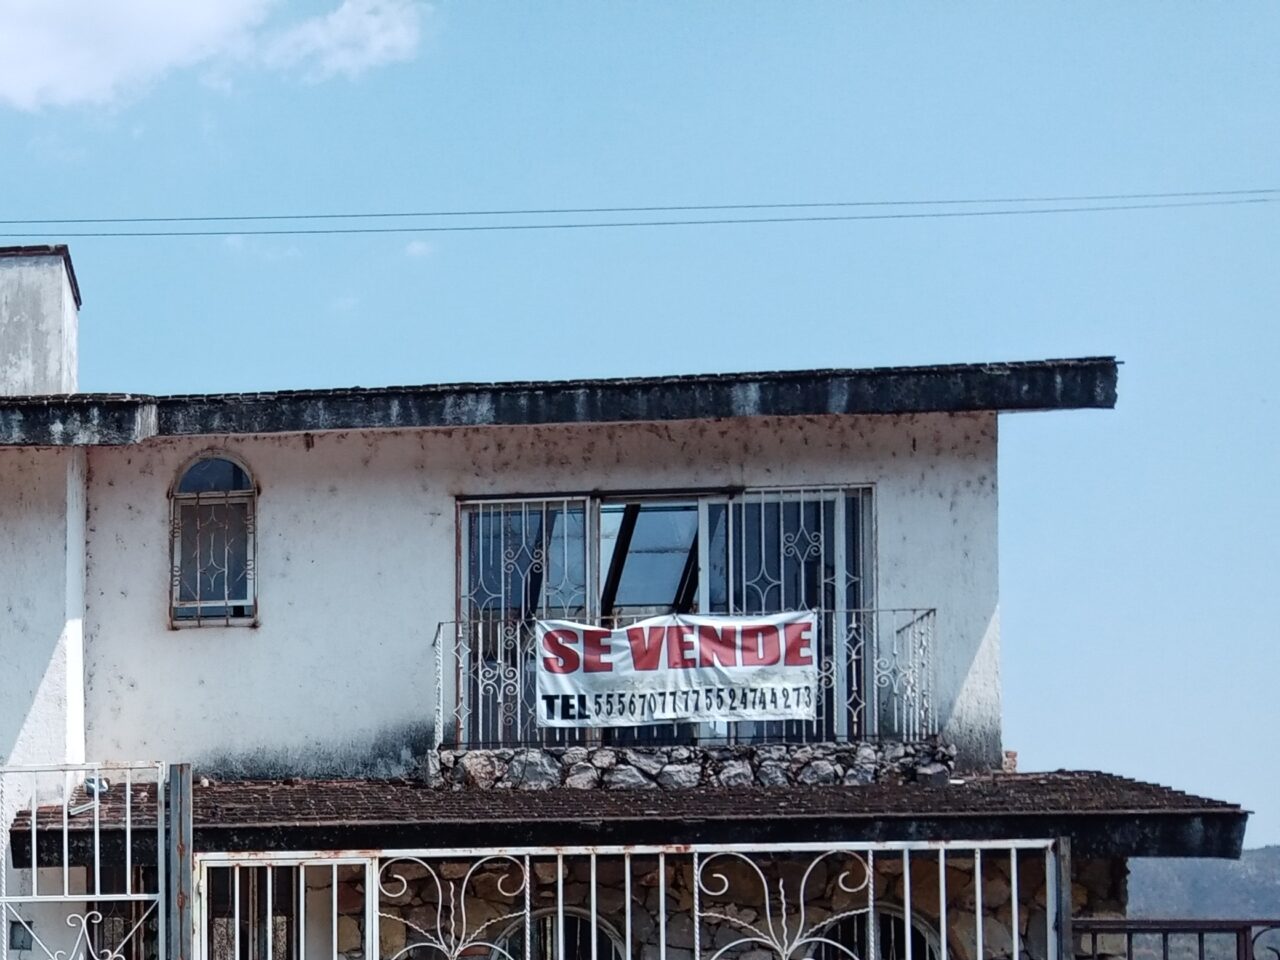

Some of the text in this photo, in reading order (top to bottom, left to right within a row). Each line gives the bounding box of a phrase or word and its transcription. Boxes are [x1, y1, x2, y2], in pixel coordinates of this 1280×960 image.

[542, 622, 813, 674] SE VENDE
[541, 694, 591, 720] TEL
